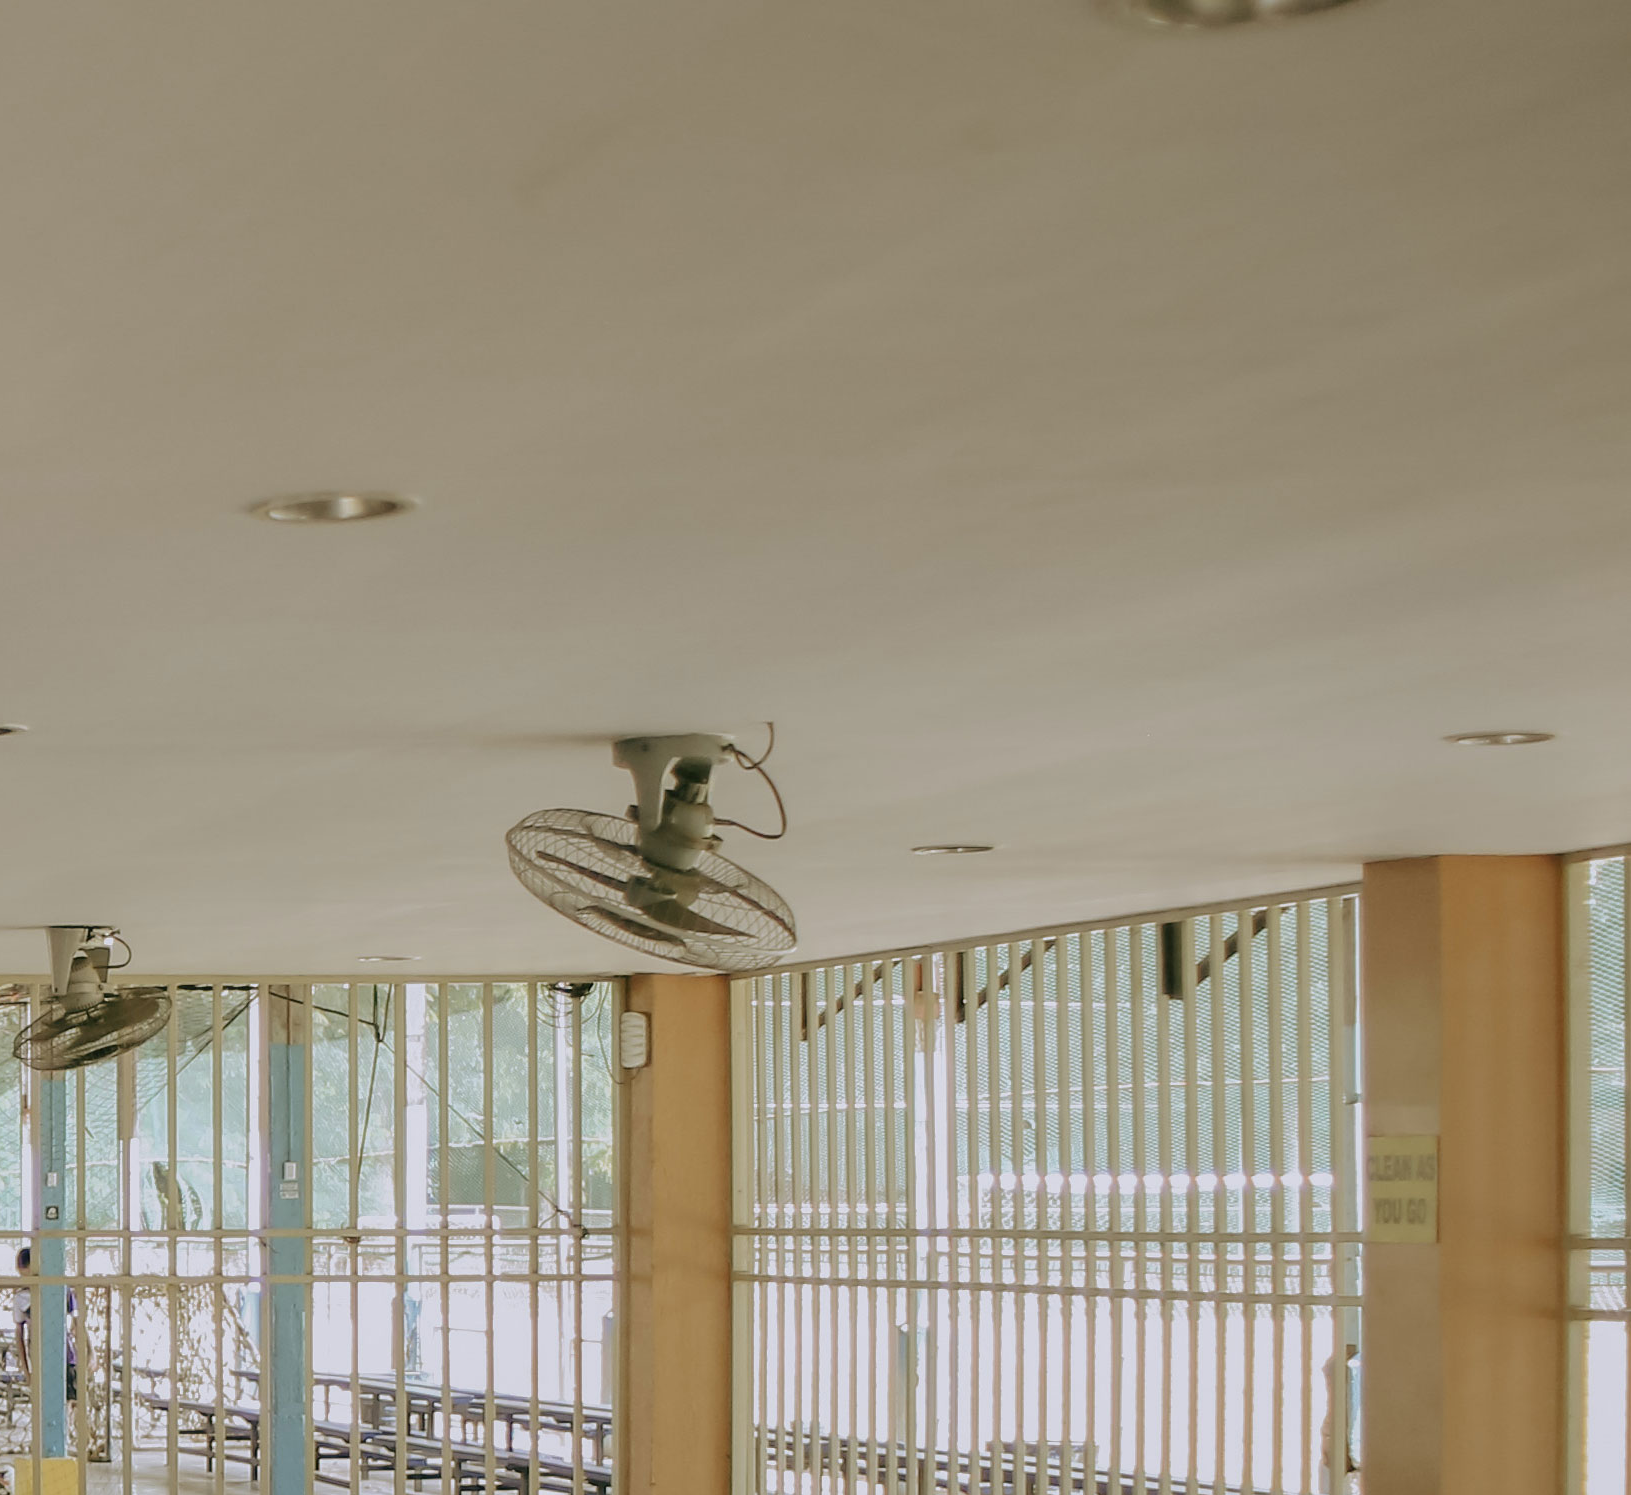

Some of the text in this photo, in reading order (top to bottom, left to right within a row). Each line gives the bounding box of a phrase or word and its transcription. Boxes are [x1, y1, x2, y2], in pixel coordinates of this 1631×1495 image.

[1367, 1154, 1436, 1182] CLEAN AS
[1373, 1198, 1427, 1225] YOU GO
